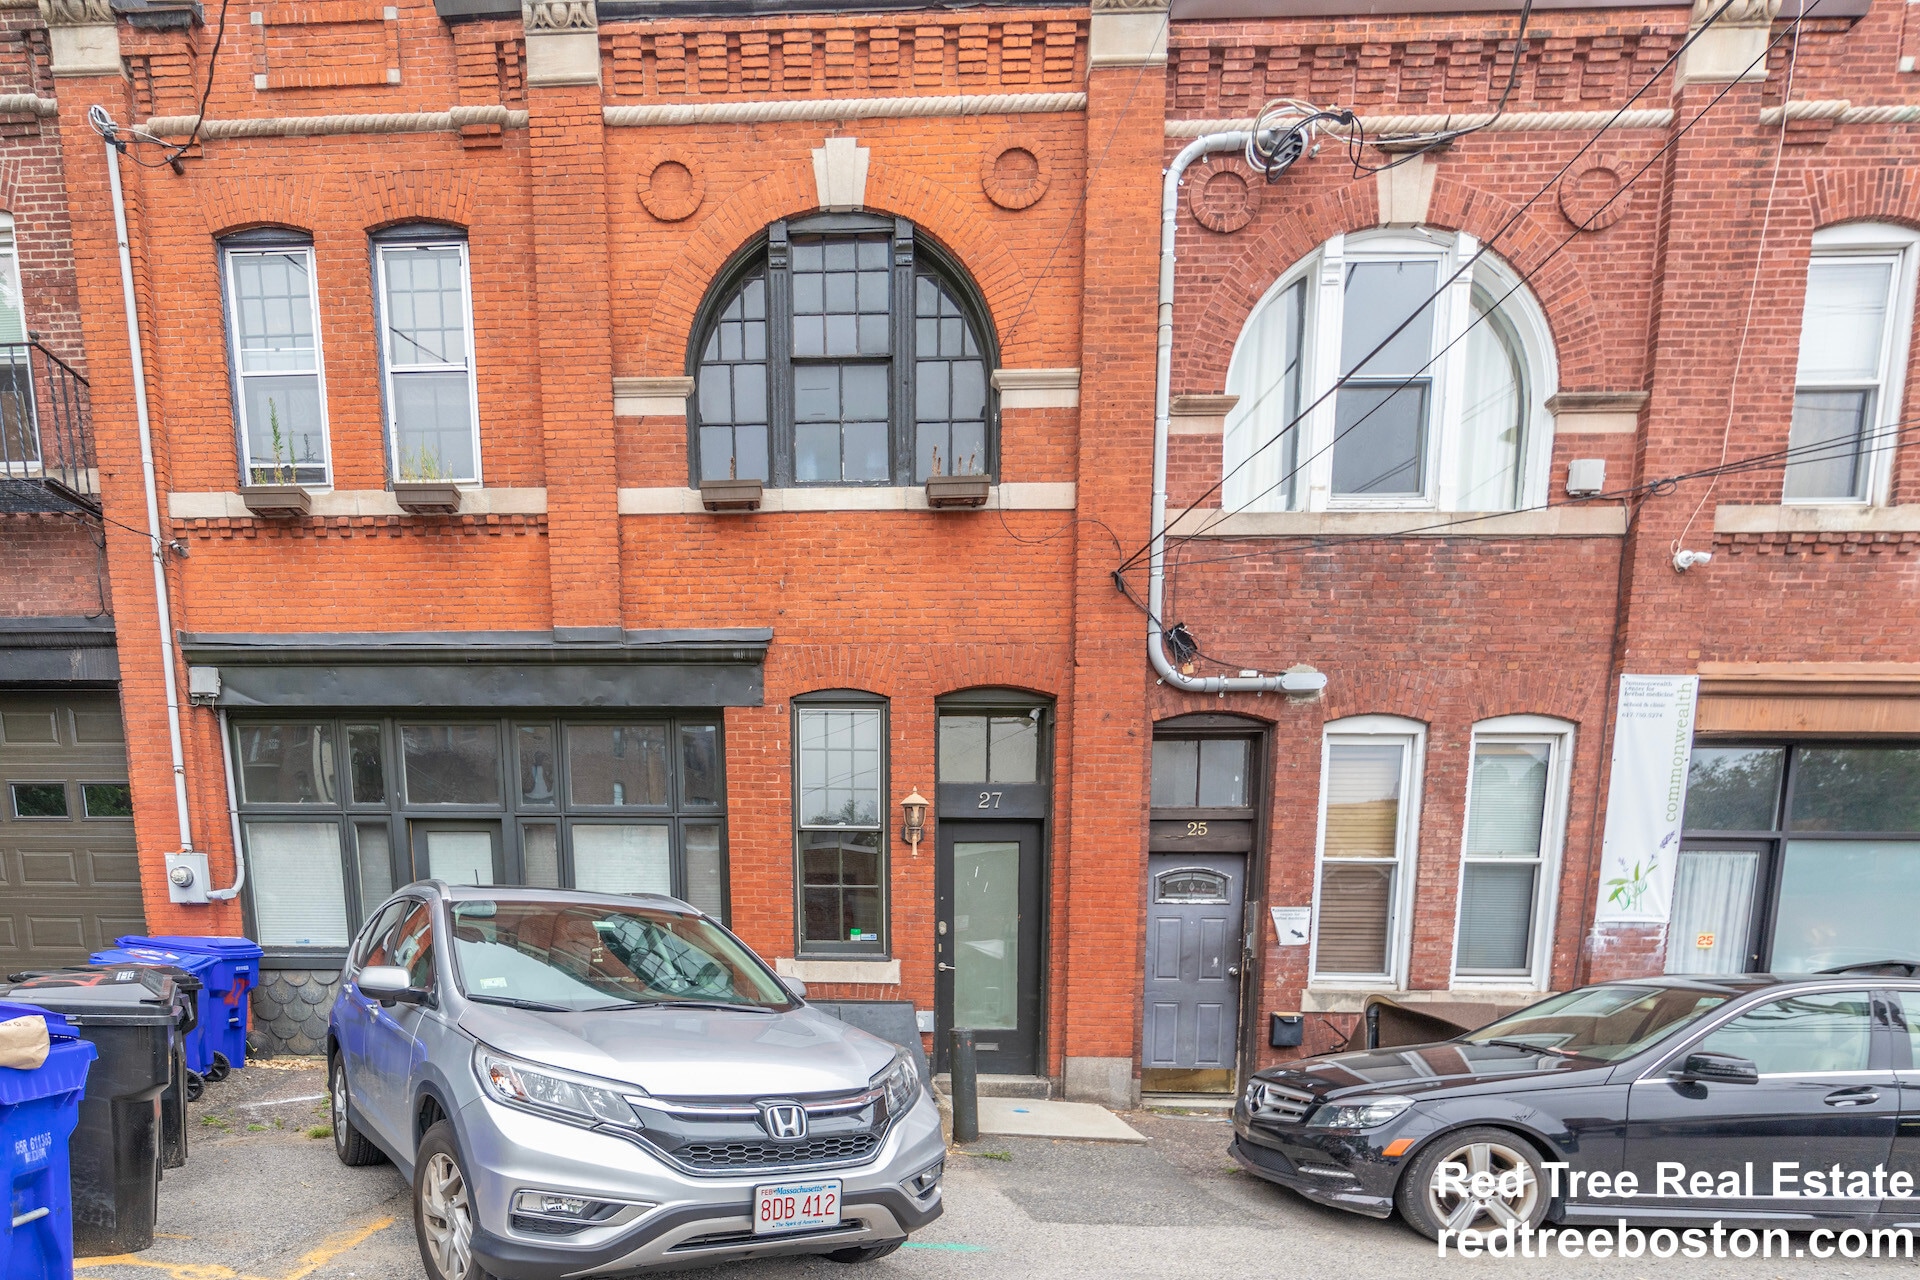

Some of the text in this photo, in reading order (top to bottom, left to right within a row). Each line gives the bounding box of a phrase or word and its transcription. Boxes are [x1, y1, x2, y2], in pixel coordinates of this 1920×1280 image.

[1665, 682, 1692, 822] commonwealth
[978, 791, 1002, 809] 27
[1187, 821, 1208, 836] 25
[1697, 935, 1713, 946] 25
[776, 1185, 824, 1195] Massachusetts
[761, 1193, 836, 1221] 8DB 412
